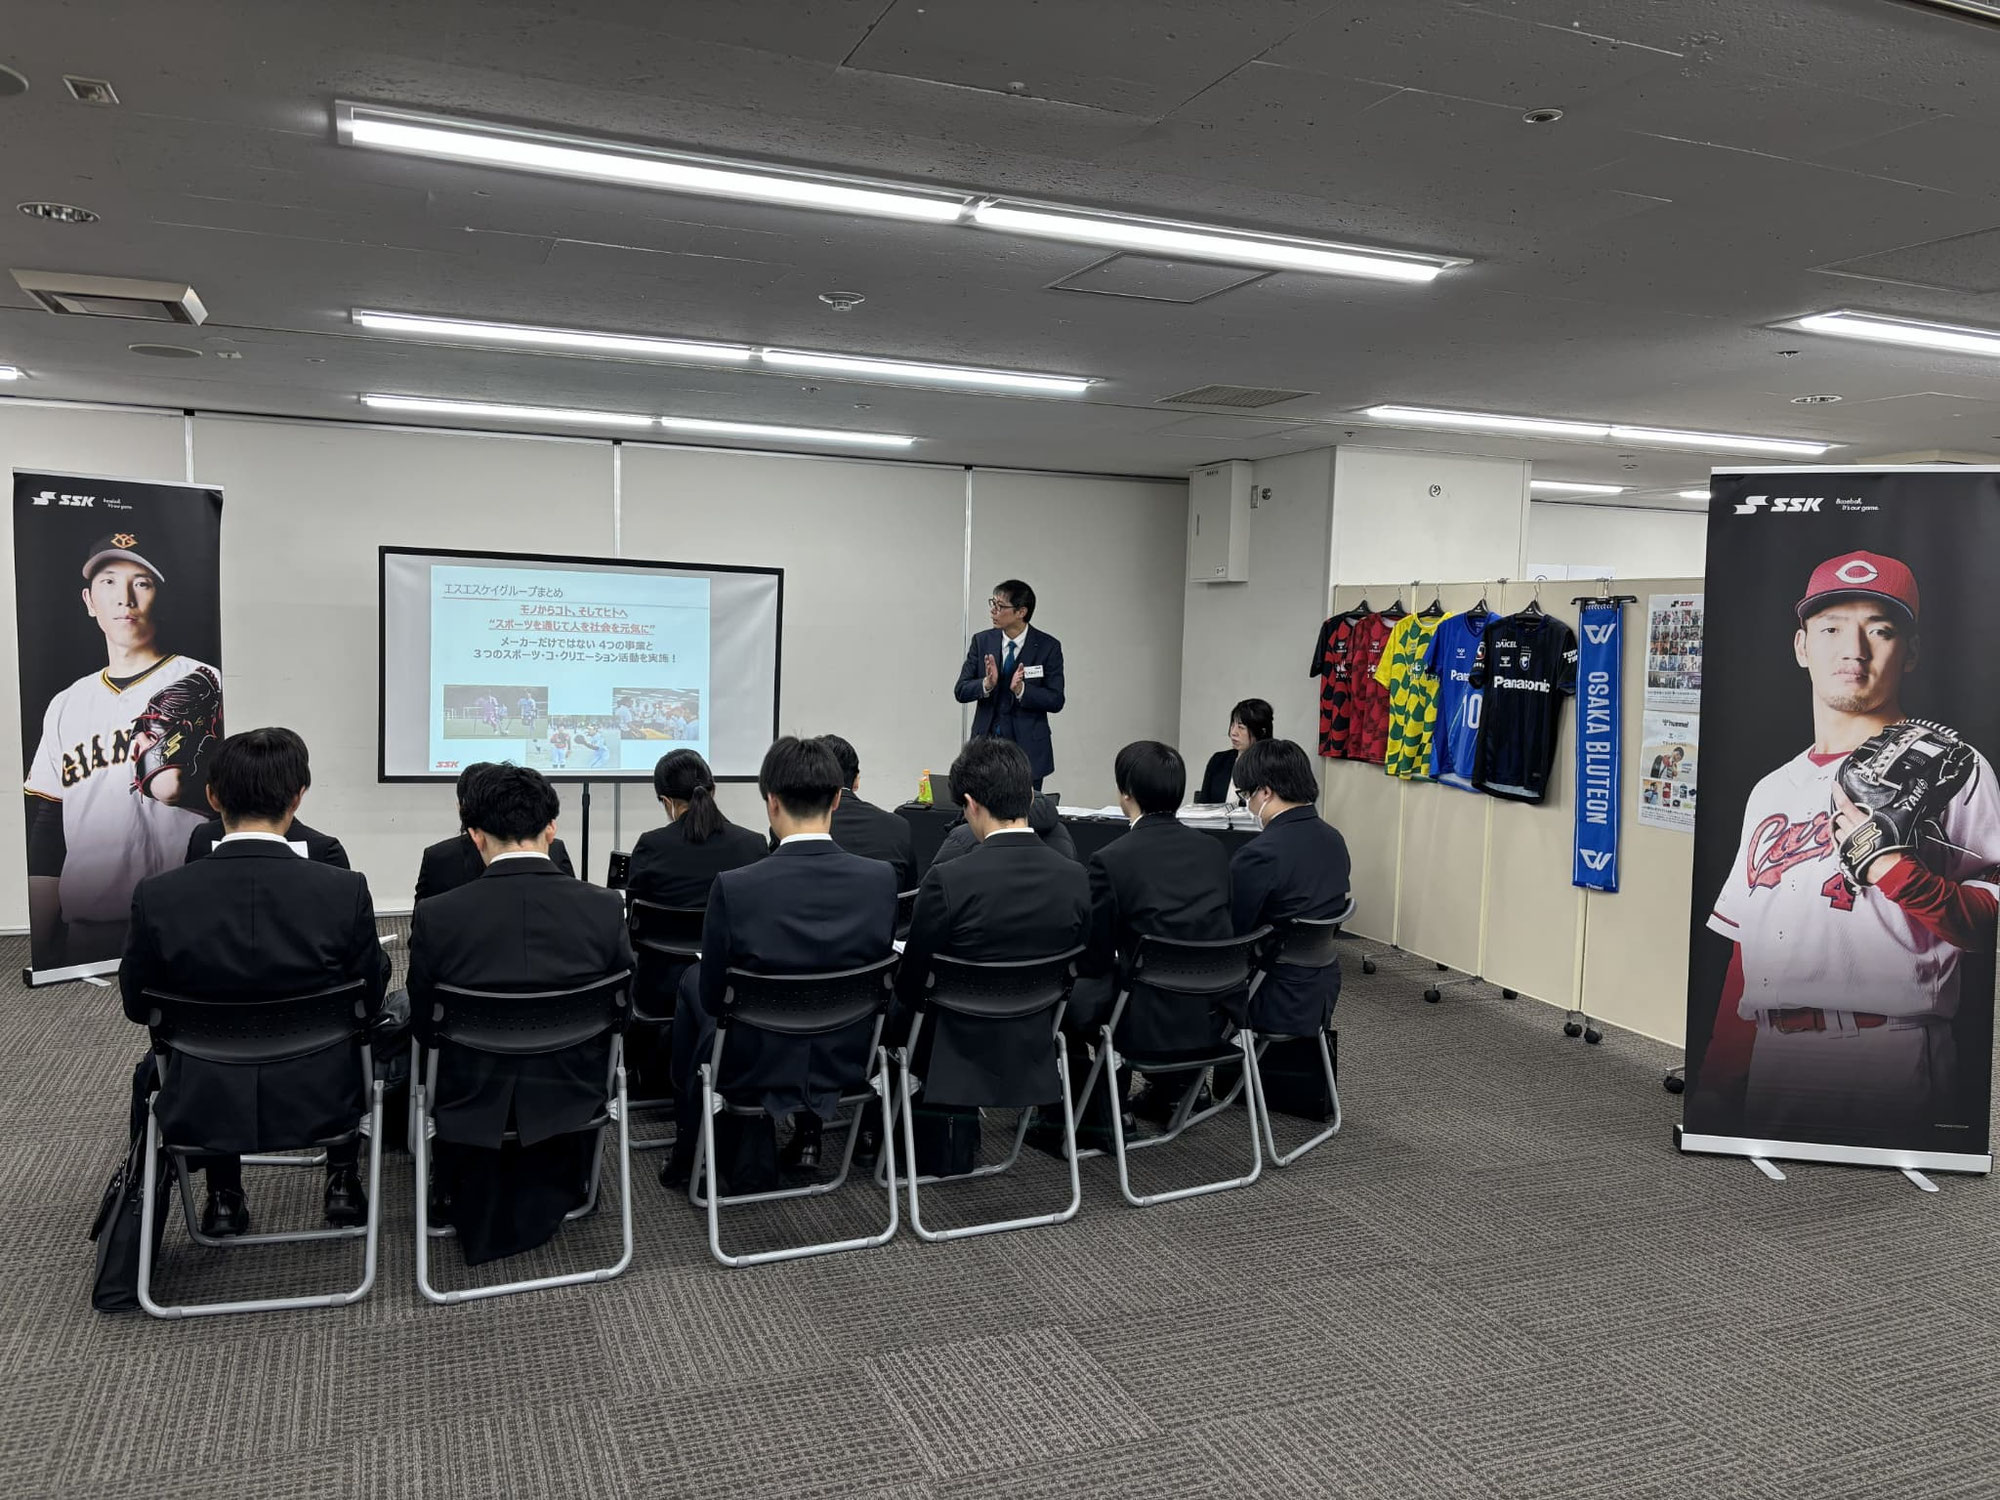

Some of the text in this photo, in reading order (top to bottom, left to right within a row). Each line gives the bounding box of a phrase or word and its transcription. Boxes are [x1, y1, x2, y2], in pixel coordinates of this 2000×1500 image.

[58, 494, 96, 508] SSK
[1770, 497, 1824, 513] SSK
[1493, 675, 1550, 693] Panasonic
[1461, 693, 1483, 729] 10
[1585, 671, 1611, 825] OSAKA BLUTEON
